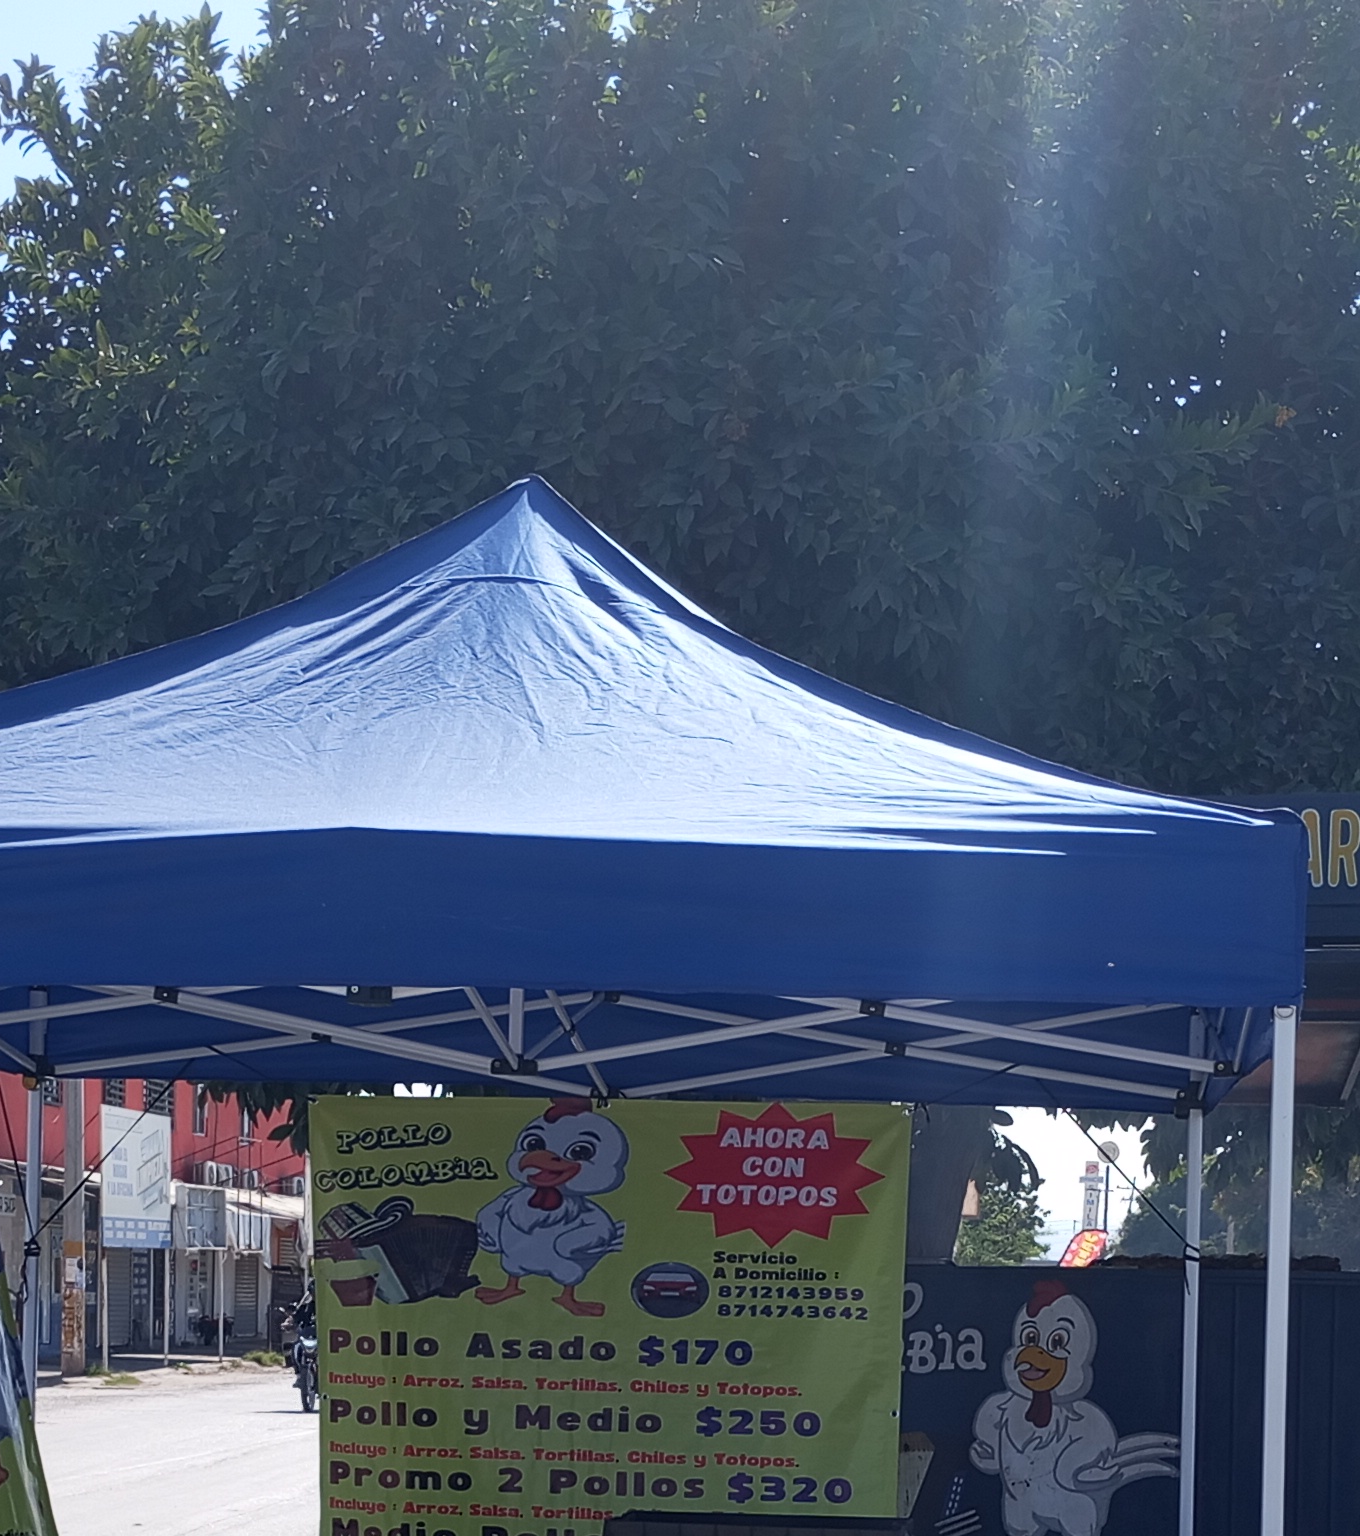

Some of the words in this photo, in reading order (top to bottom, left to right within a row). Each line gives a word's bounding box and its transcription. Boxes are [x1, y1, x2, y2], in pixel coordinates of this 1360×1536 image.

[336, 1123, 452, 1154] POLLO
[719, 1127, 830, 1150] AHORA
[742, 1156, 805, 1178] CON
[696, 1183, 838, 1207] TOTOPOS
[713, 1250, 798, 1265] Servicio
[713, 1266, 727, 1279] A
[734, 1267, 828, 1281] Domicilio
[718, 1285, 864, 1301] 8712143959
[717, 1304, 869, 1321] 8714743642
[328, 1328, 439, 1357] Pollo
[465, 1332, 617, 1361] Asado
[638, 1335, 754, 1367] $170
[328, 1371, 386, 1389] Incluye
[629, 1379, 690, 1395] Chiles
[696, 1383, 710, 1397] y
[717, 1381, 803, 1398] Totopos.
[329, 1398, 438, 1428] Pollo
[463, 1408, 489, 1436] y
[515, 1403, 663, 1433] Medio
[695, 1406, 822, 1437] $250
[329, 1441, 387, 1458] Incluye
[627, 1450, 686, 1465] Chiles
[693, 1454, 706, 1468] y
[714, 1453, 800, 1468] Totopos.
[329, 1460, 472, 1492] Promo
[497, 1467, 523, 1493] 2
[549, 1469, 705, 1499] Pollos
[727, 1472, 852, 1504] $320
[329, 1497, 387, 1515] Incluye
